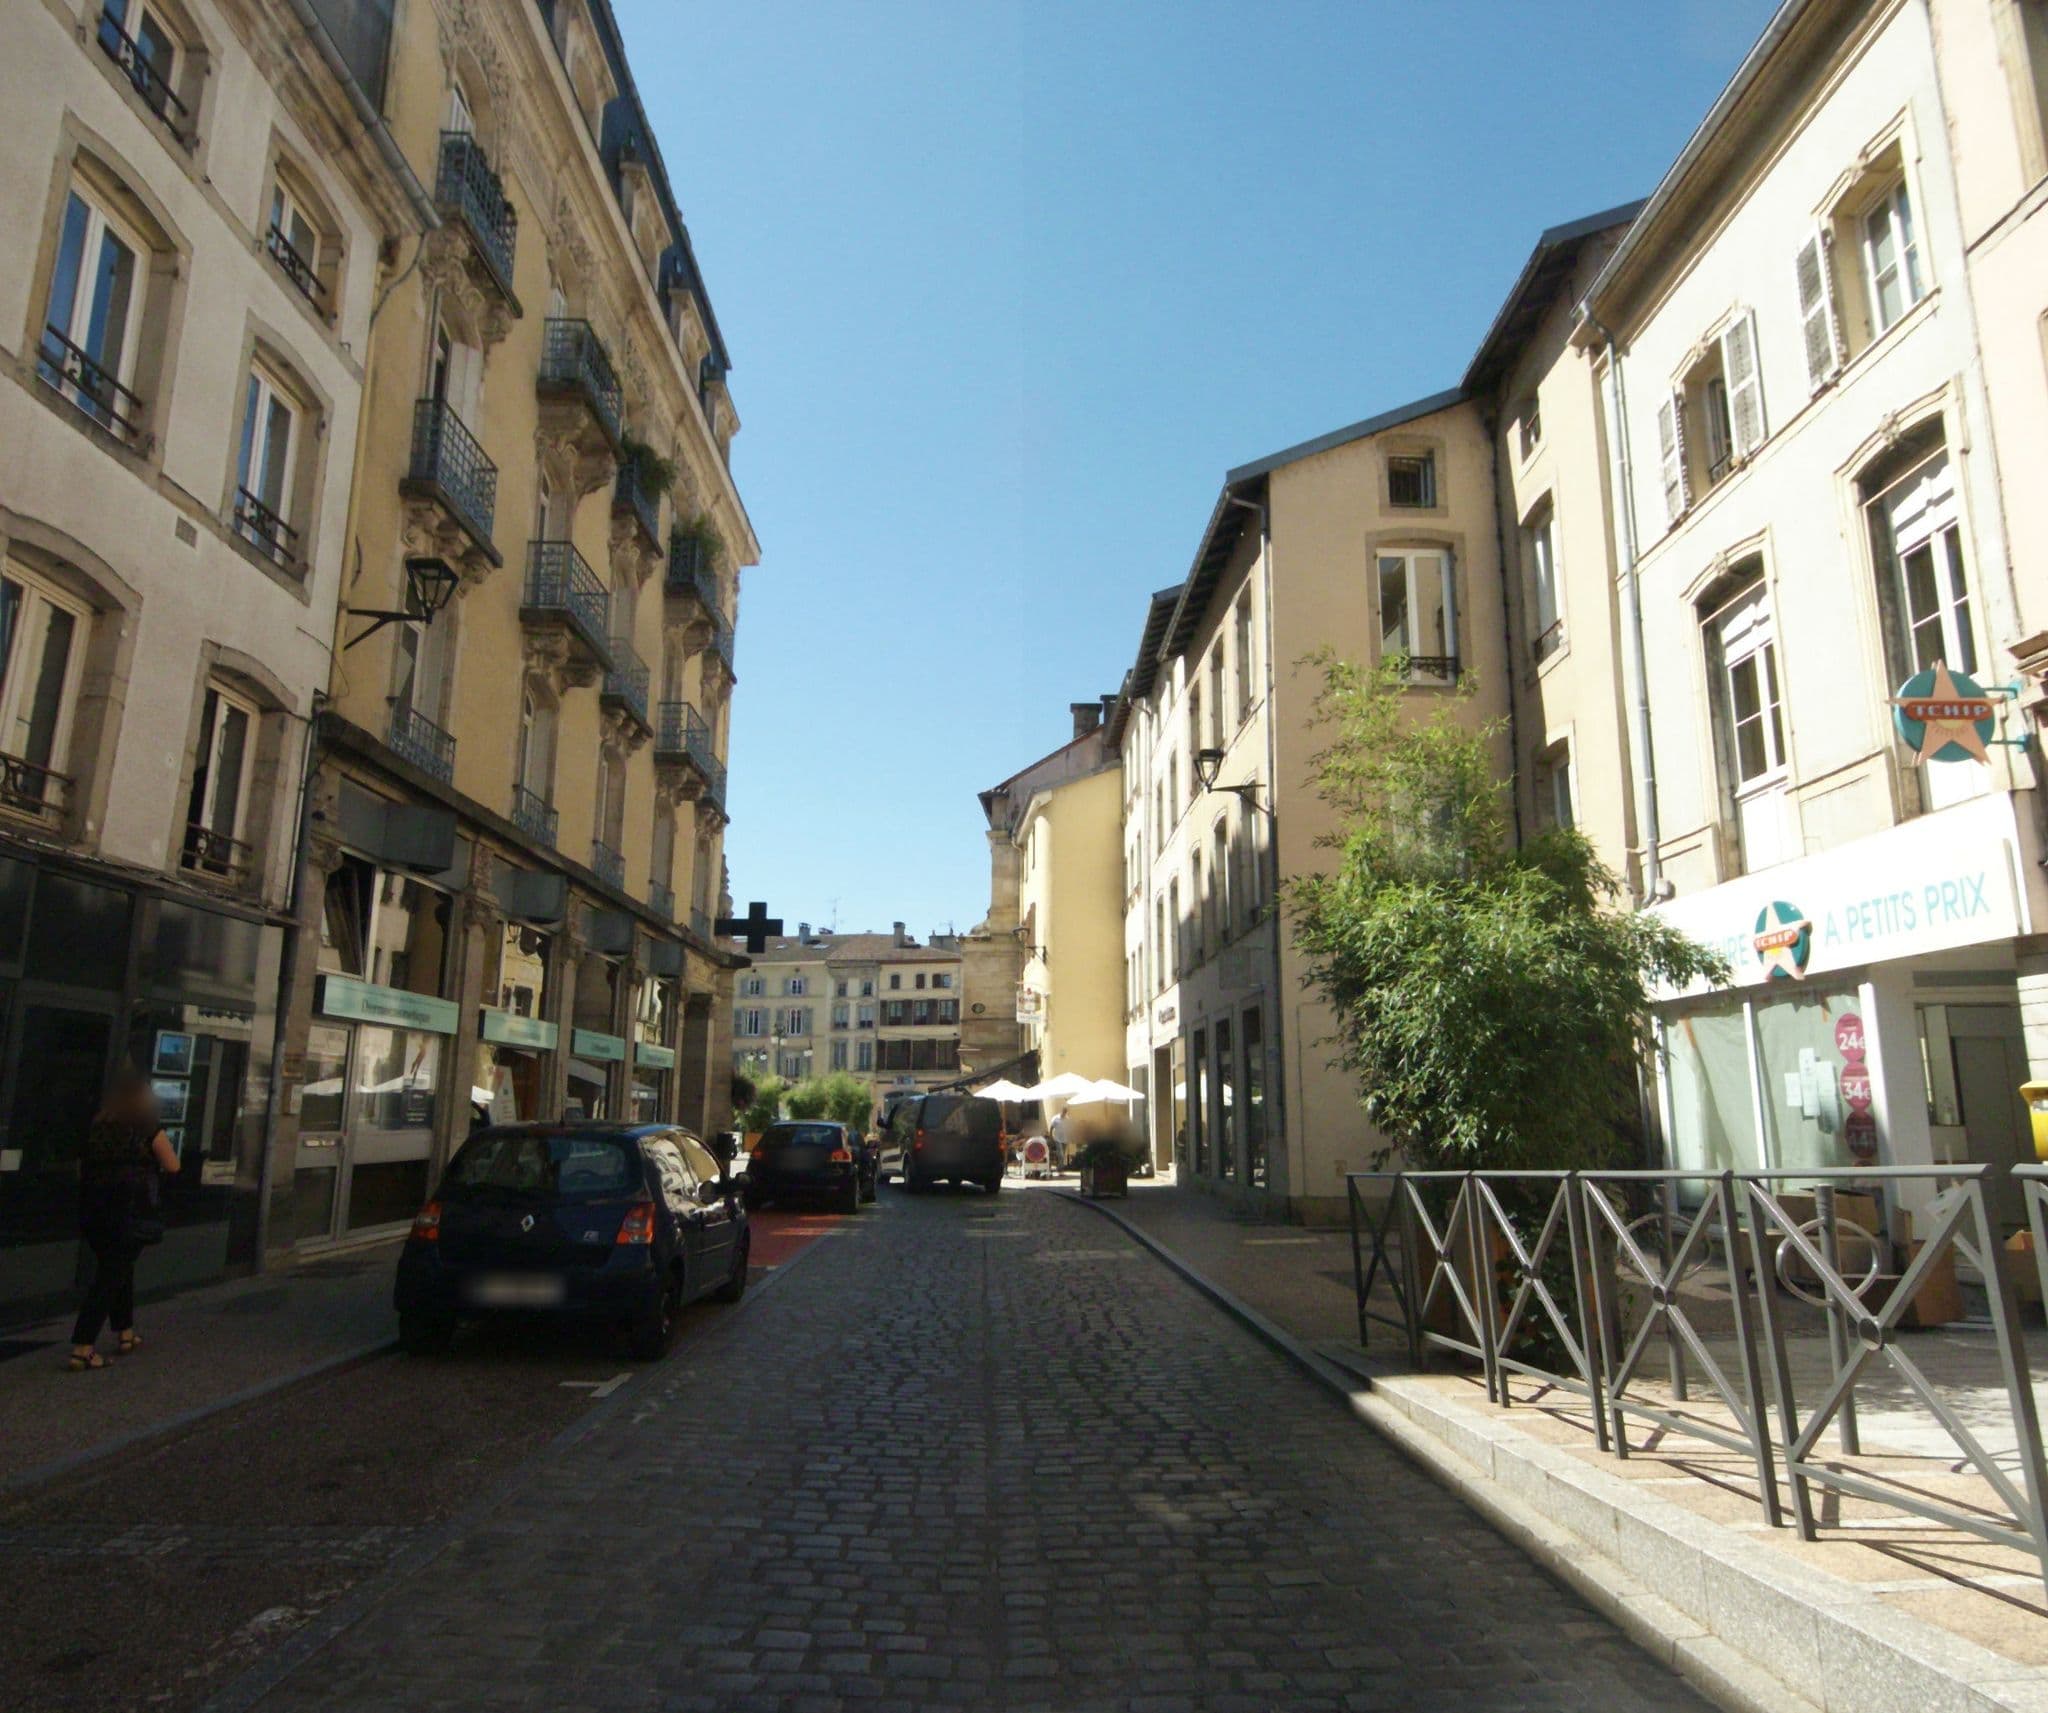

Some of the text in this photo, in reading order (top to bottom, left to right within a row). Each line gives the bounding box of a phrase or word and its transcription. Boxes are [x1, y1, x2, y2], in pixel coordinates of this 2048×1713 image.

[1911, 704, 1988, 717] TCHIP
[1825, 911, 1841, 945] A
[1846, 890, 1917, 942] PETITS
[1924, 871, 1991, 926] PRIX
